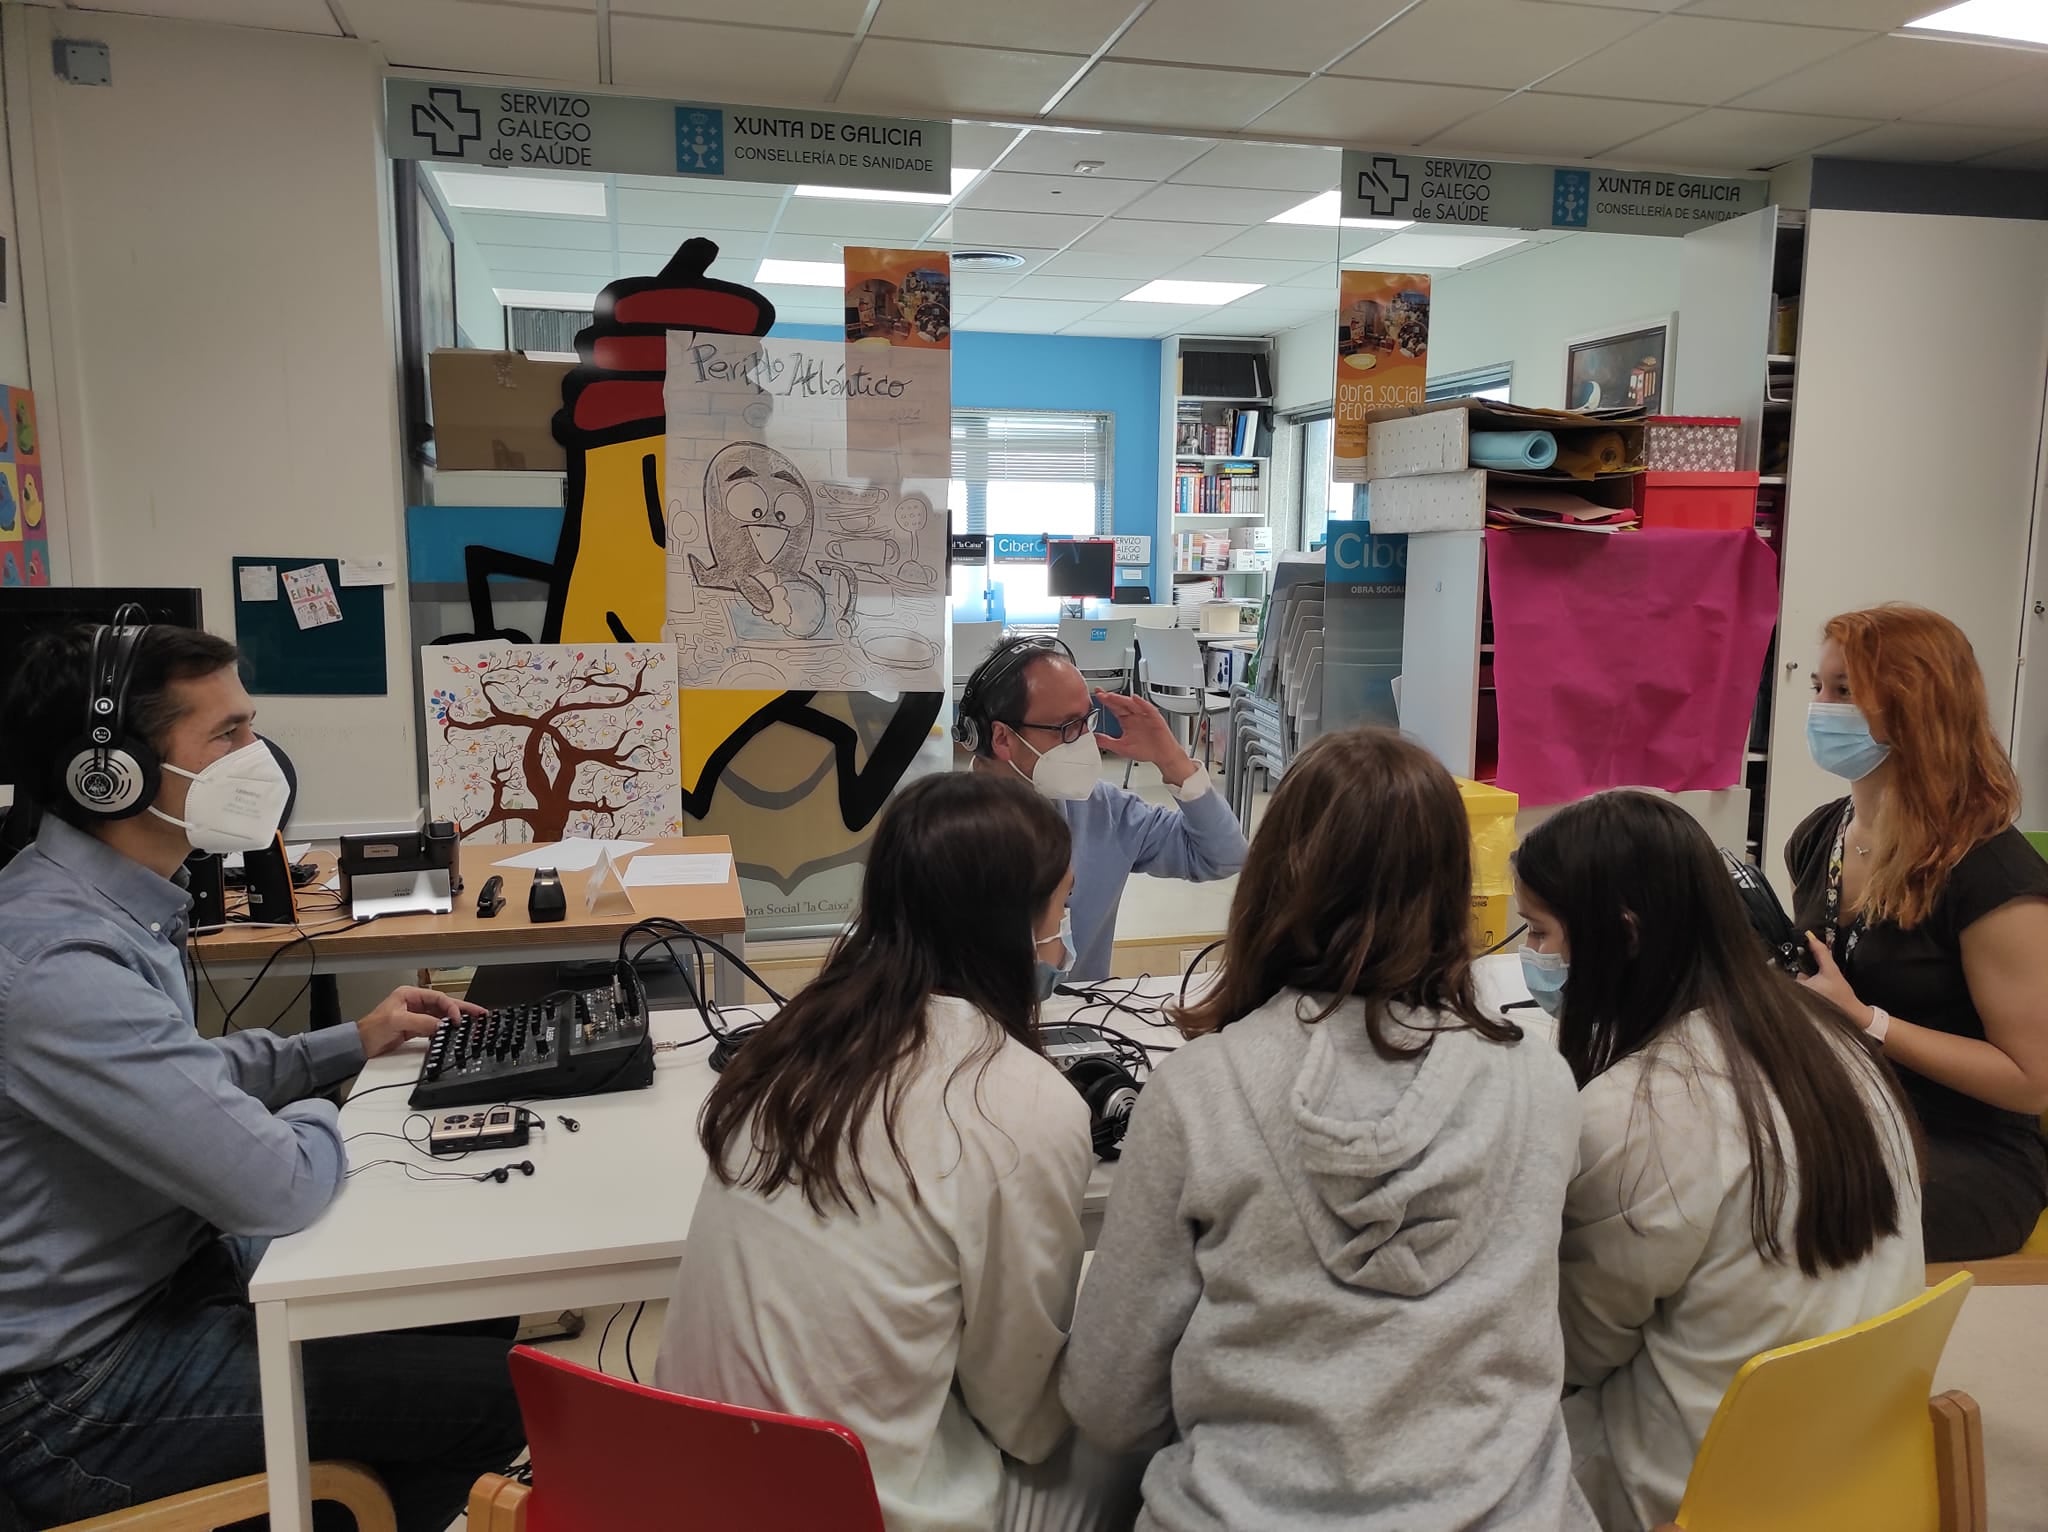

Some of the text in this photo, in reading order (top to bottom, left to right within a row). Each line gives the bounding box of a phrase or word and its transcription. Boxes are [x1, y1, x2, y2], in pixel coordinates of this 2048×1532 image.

[500, 92, 591, 119] SERVIZO
[497, 118, 592, 143] GALEGO
[734, 116, 922, 147] XUNTA DE GALICIA
[488, 139, 593, 167] de SAÚDE
[734, 146, 934, 172] CONSELLERÍA DE SANIDADE
[1424, 160, 1491, 181] SERVIZO
[1421, 181, 1490, 202] GALEGO
[1598, 177, 1741, 202] XUNTA DE GALICIA
[1412, 199, 1489, 222] de SAÚDE
[1596, 202, 1673, 218] CONSELLERÍA
[1675, 207, 1689, 220] DE
[780, 352, 913, 398] Atlántico
[745, 904, 764, 917] bra
[766, 903, 800, 915] Social
